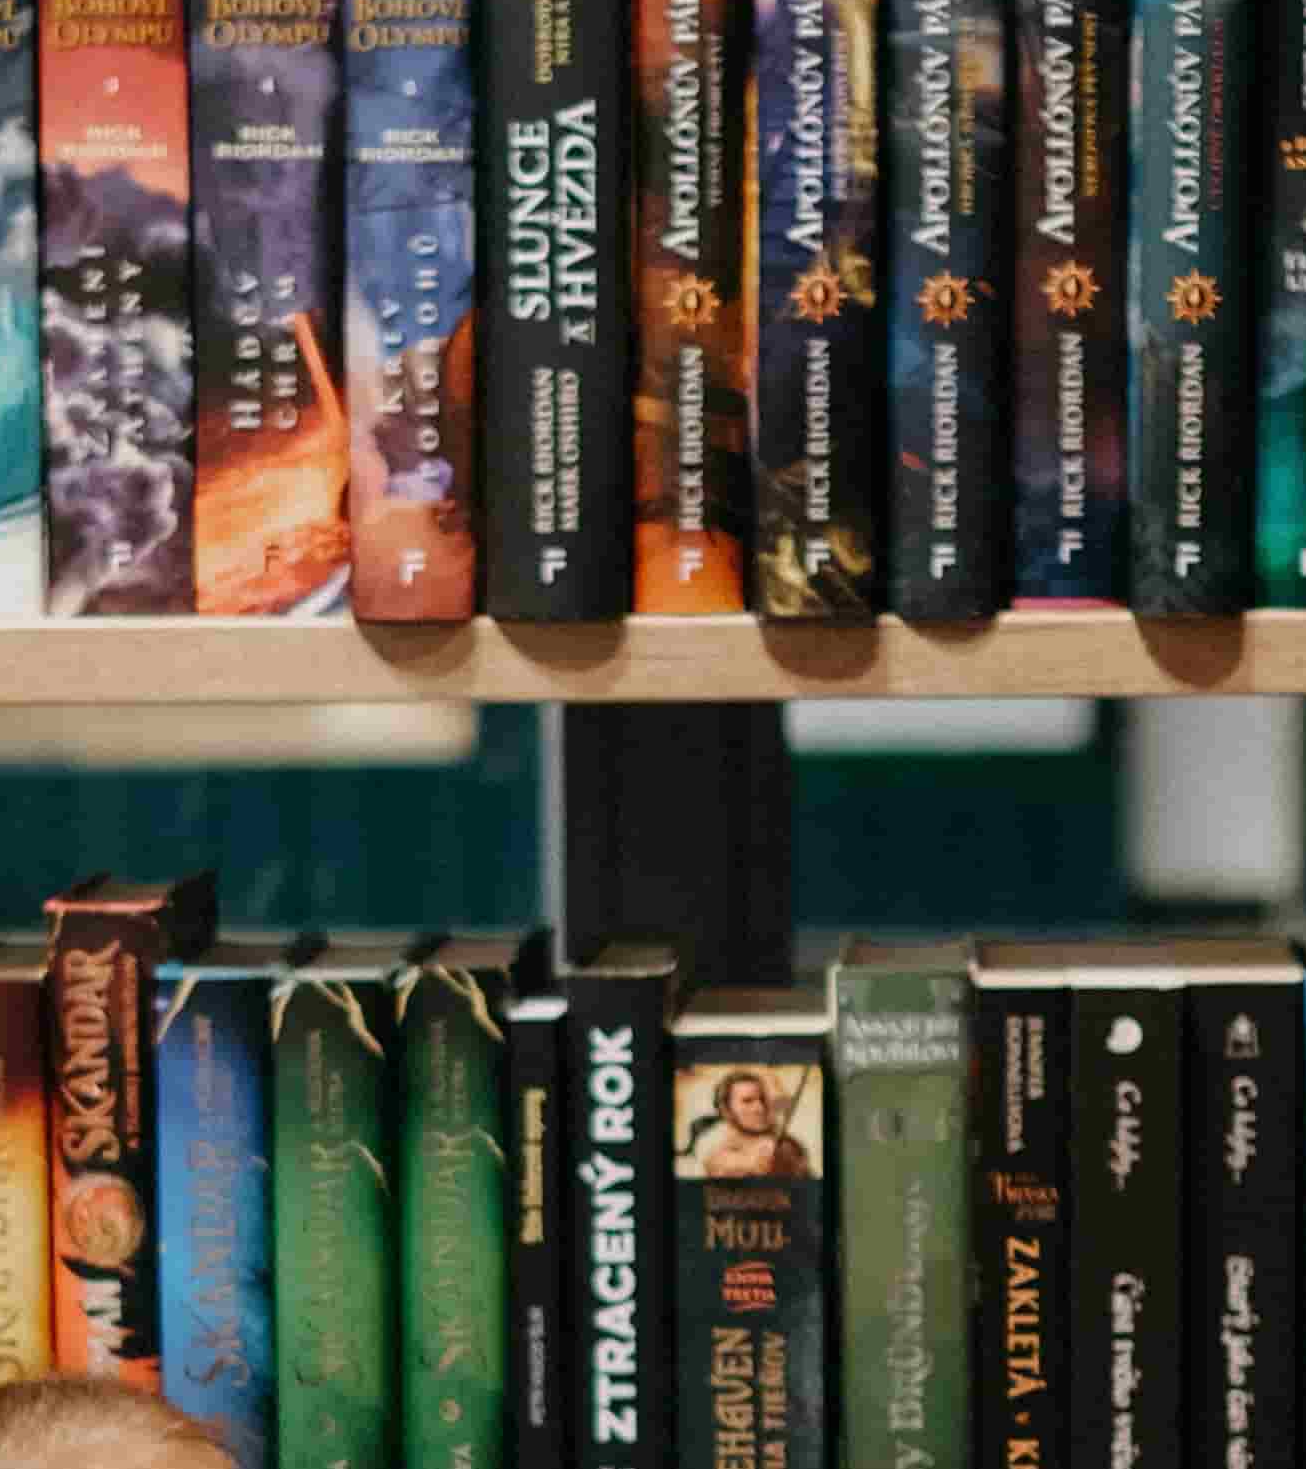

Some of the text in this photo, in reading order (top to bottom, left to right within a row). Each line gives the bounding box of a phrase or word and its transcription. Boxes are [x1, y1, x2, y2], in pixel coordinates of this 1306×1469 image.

[507, 121, 551, 321] SLUNCE
[553, 100, 597, 310] HVĚZDA
[660, 50, 701, 261] APOLLÓNŮV
[786, 42, 825, 252] APOLLÓNŮV
[911, 46, 951, 254] APOLLÓNŮV
[1038, 38, 1076, 245] APOLLÓNŮV
[1164, 45, 1204, 253] APOLLÓNŮV
[532, 367, 558, 534] RICK RIORDAN
[558, 369, 583, 533] MARK OSHIRO
[678, 346, 706, 532] RICK RIORDAN
[805, 337, 833, 522] RICK RIORDAN
[930, 341, 958, 530] RICK RIORDAN
[1055, 331, 1084, 518] RICK RIORDAN
[1178, 341, 1204, 528] RICK RIORDAN
[61, 942, 119, 1162] SKANDAR
[185, 1140, 251, 1386] SKANDAR
[579, 1026, 638, 1444] ZTRACENÝ ROK
[1006, 1236, 1048, 1398] ZAKLETÁ
